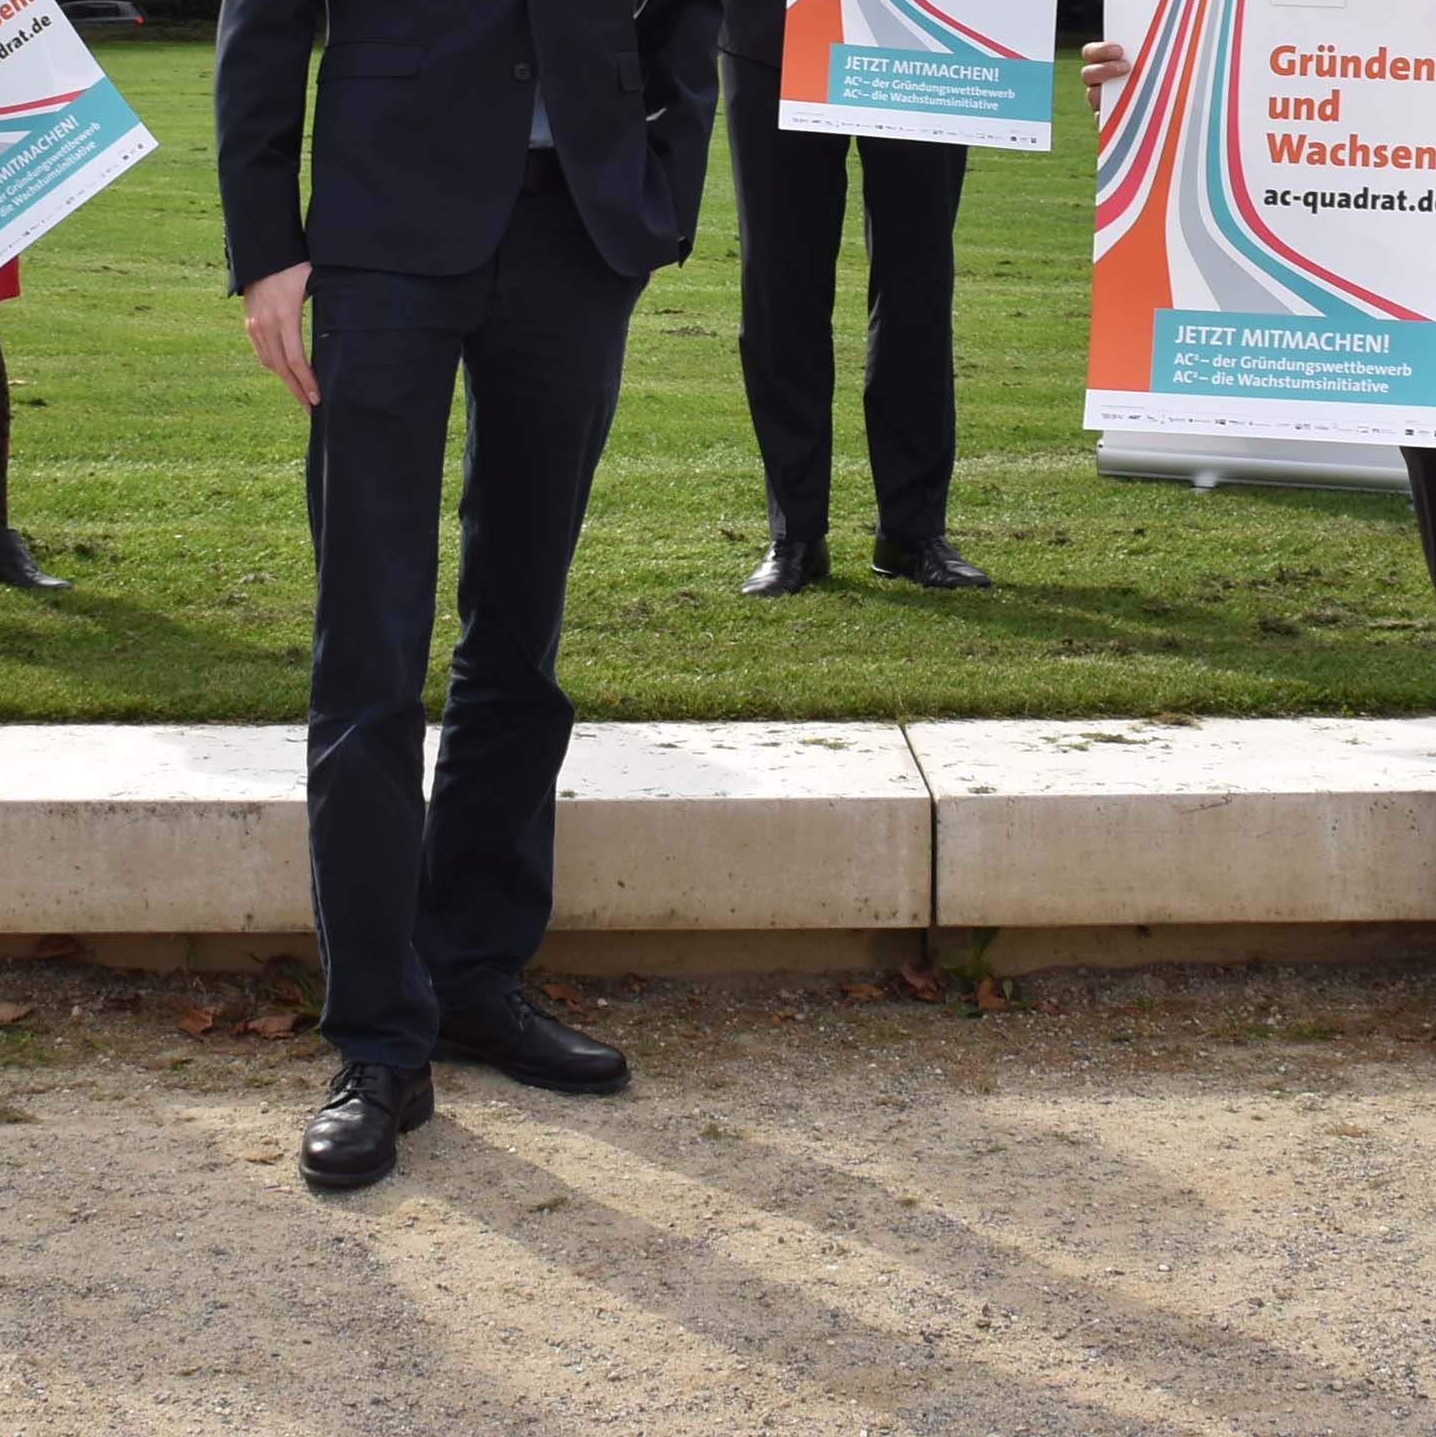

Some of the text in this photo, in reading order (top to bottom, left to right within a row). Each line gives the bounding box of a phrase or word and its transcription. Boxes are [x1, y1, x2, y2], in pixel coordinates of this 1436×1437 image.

[844, 56, 1000, 82] JETZT MITMACHEN!
[1269, 44, 1436, 81] Gründen
[871, 78, 890, 89] der
[892, 80, 1015, 99] Gründungswettbewerb
[871, 90, 889, 101] die
[890, 92, 999, 110] Wachstumsinitiative
[1268, 89, 1340, 122] und
[1174, 325, 1390, 354] JETZT MITMACHEN!
[1212, 354, 1237, 368] der
[1240, 355, 1412, 377] Gründungswettbewerb
[1212, 372, 1234, 385] die
[1237, 373, 1389, 394] Wachstumsinitiative
